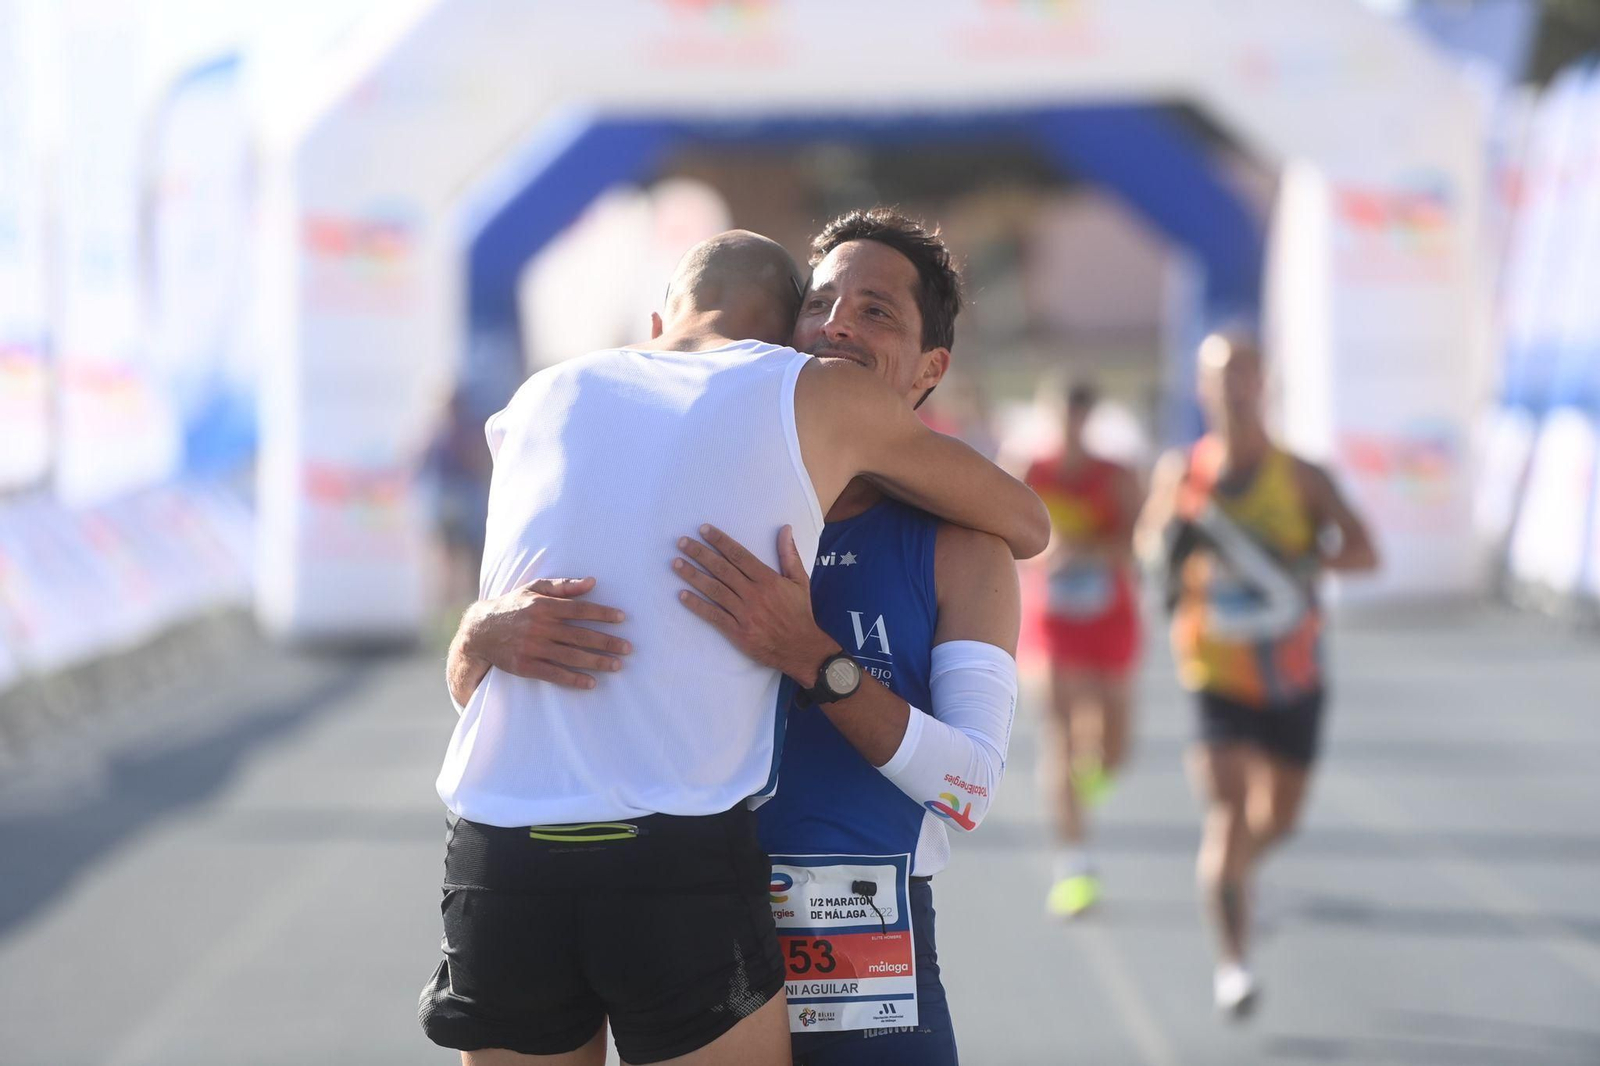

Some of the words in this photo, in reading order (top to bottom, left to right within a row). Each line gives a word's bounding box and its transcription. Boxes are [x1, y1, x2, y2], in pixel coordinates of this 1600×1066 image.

[847, 610, 892, 656] VA
[810, 897, 824, 907] 1/2
[826, 895, 873, 907] MARATÓN
[810, 911, 823, 920] DE
[825, 908, 867, 920] MÁLAGA
[789, 939, 837, 974] 53
[785, 985, 797, 995] NI
[802, 982, 859, 995] AGUILAR
